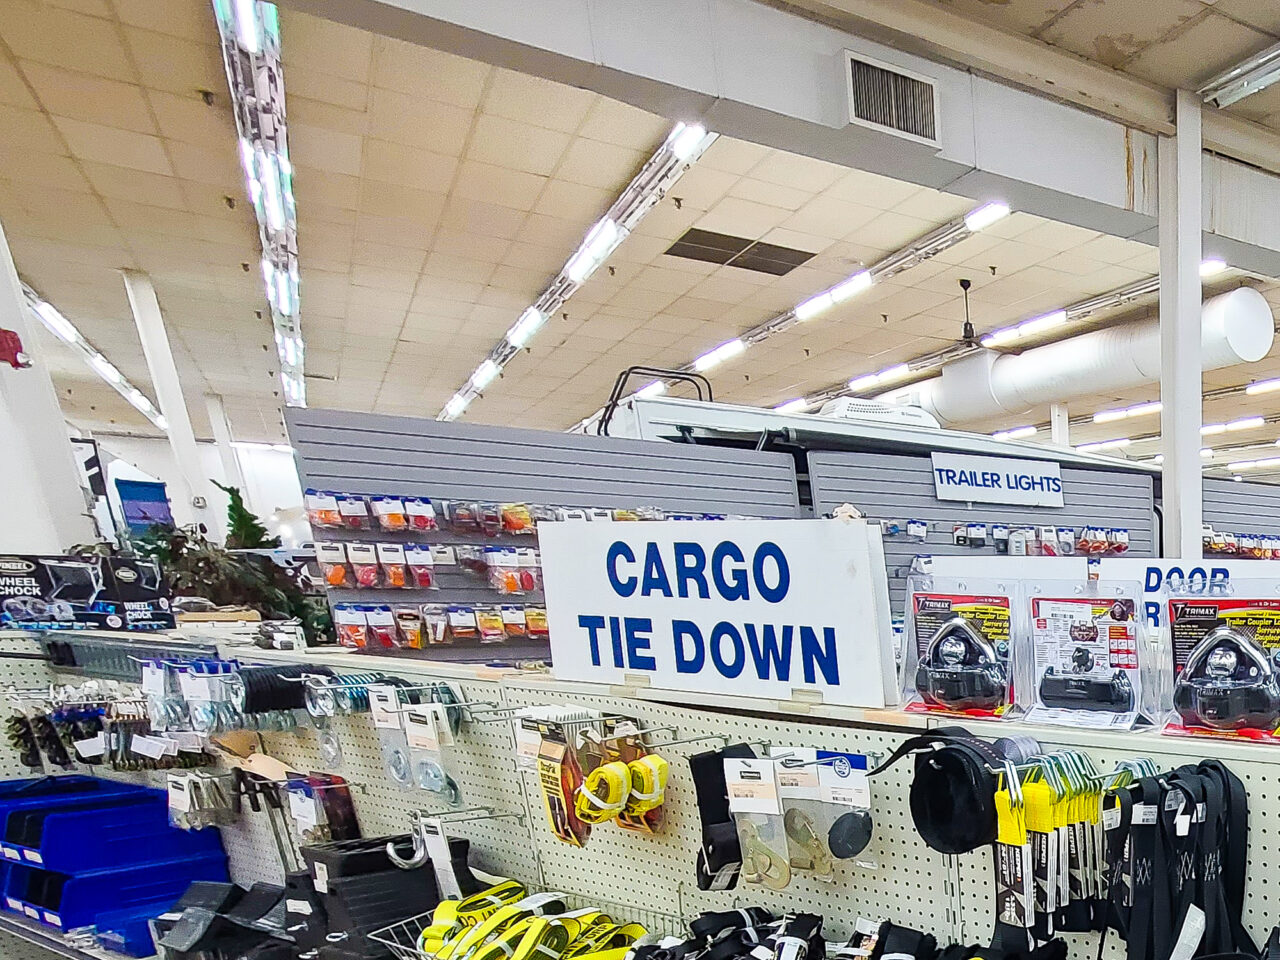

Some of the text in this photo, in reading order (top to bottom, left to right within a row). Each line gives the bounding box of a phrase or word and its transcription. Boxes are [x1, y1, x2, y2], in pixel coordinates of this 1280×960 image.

[935, 468, 1062, 493] TRAILER LIGHTS
[606, 540, 791, 604] CARGO
[123, 602, 150, 611] WHEEL
[925, 600, 949, 609] TRIMAX
[126, 610, 153, 619] CHOCK
[1185, 607, 1215, 616] TRIMAX
[1226, 617, 1247, 627] Trailer
[1247, 618, 1273, 628] Coupler
[577, 614, 657, 671] TIE
[672, 619, 841, 686] DOWN
